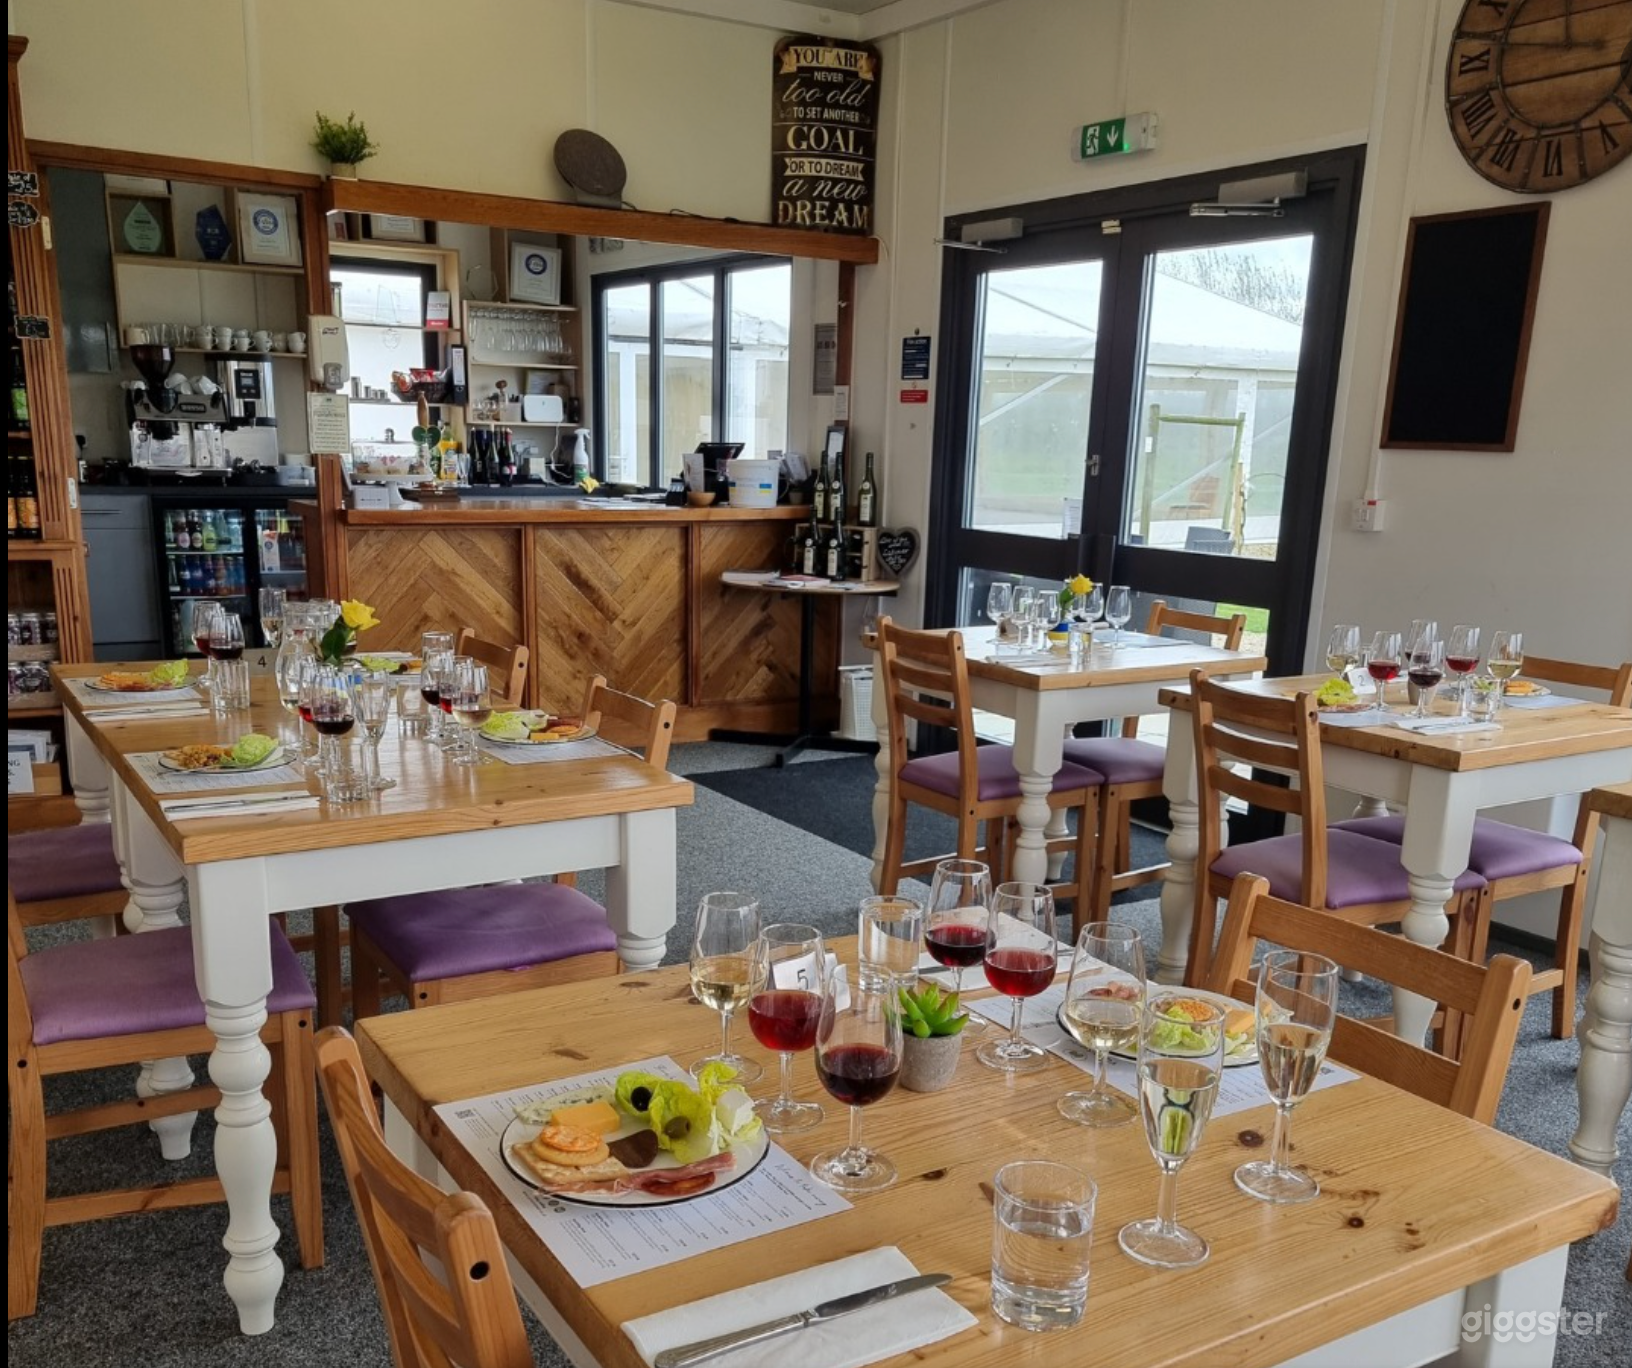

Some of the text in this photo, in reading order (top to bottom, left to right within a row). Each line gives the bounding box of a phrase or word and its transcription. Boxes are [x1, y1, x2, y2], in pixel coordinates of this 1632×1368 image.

[794, 47, 827, 65] YOU
[813, 71, 844, 83] NEVER
[782, 78, 871, 107] too old
[793, 106, 859, 123] TO SET ANOTHER
[786, 125, 864, 155] GOAL
[789, 161, 859, 178] OR TO DREAM
[782, 178, 867, 200] a new
[778, 200, 868, 228] DREAM
[257, 654, 268, 669] 4
[1357, 674, 1366, 687] 2
[797, 968, 809, 990] 5
